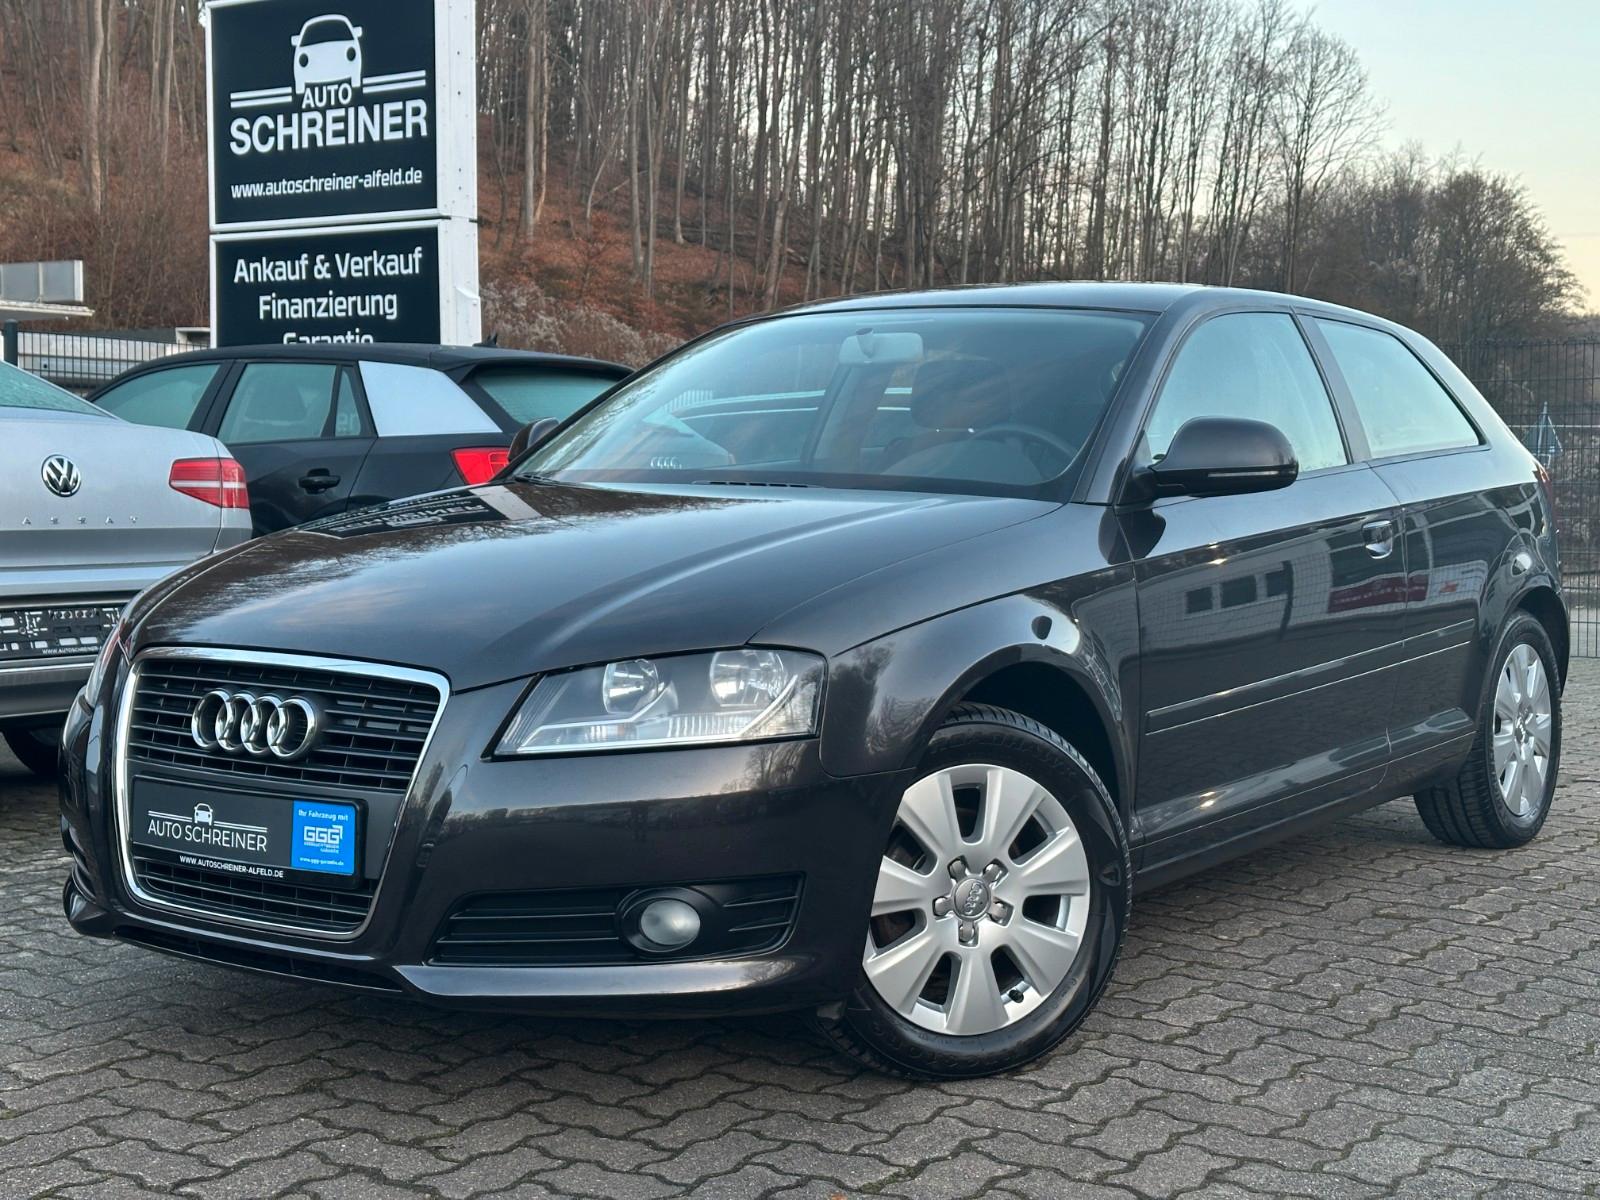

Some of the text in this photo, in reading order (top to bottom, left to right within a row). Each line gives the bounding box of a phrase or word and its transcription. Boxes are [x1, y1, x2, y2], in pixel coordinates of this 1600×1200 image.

[302, 83, 352, 108] AUTO
[229, 99, 428, 155] SCHREINER
[231, 167, 423, 198] www.autoschreiner-alfeld.de
[233, 246, 423, 283] Ankauf & Verkauf
[258, 290, 398, 320] Finanzierung
[147, 819, 267, 852] AUTO SCHREINER
[179, 855, 284, 879] WWW.AUTOSCHREINER-ALFELD.DE
